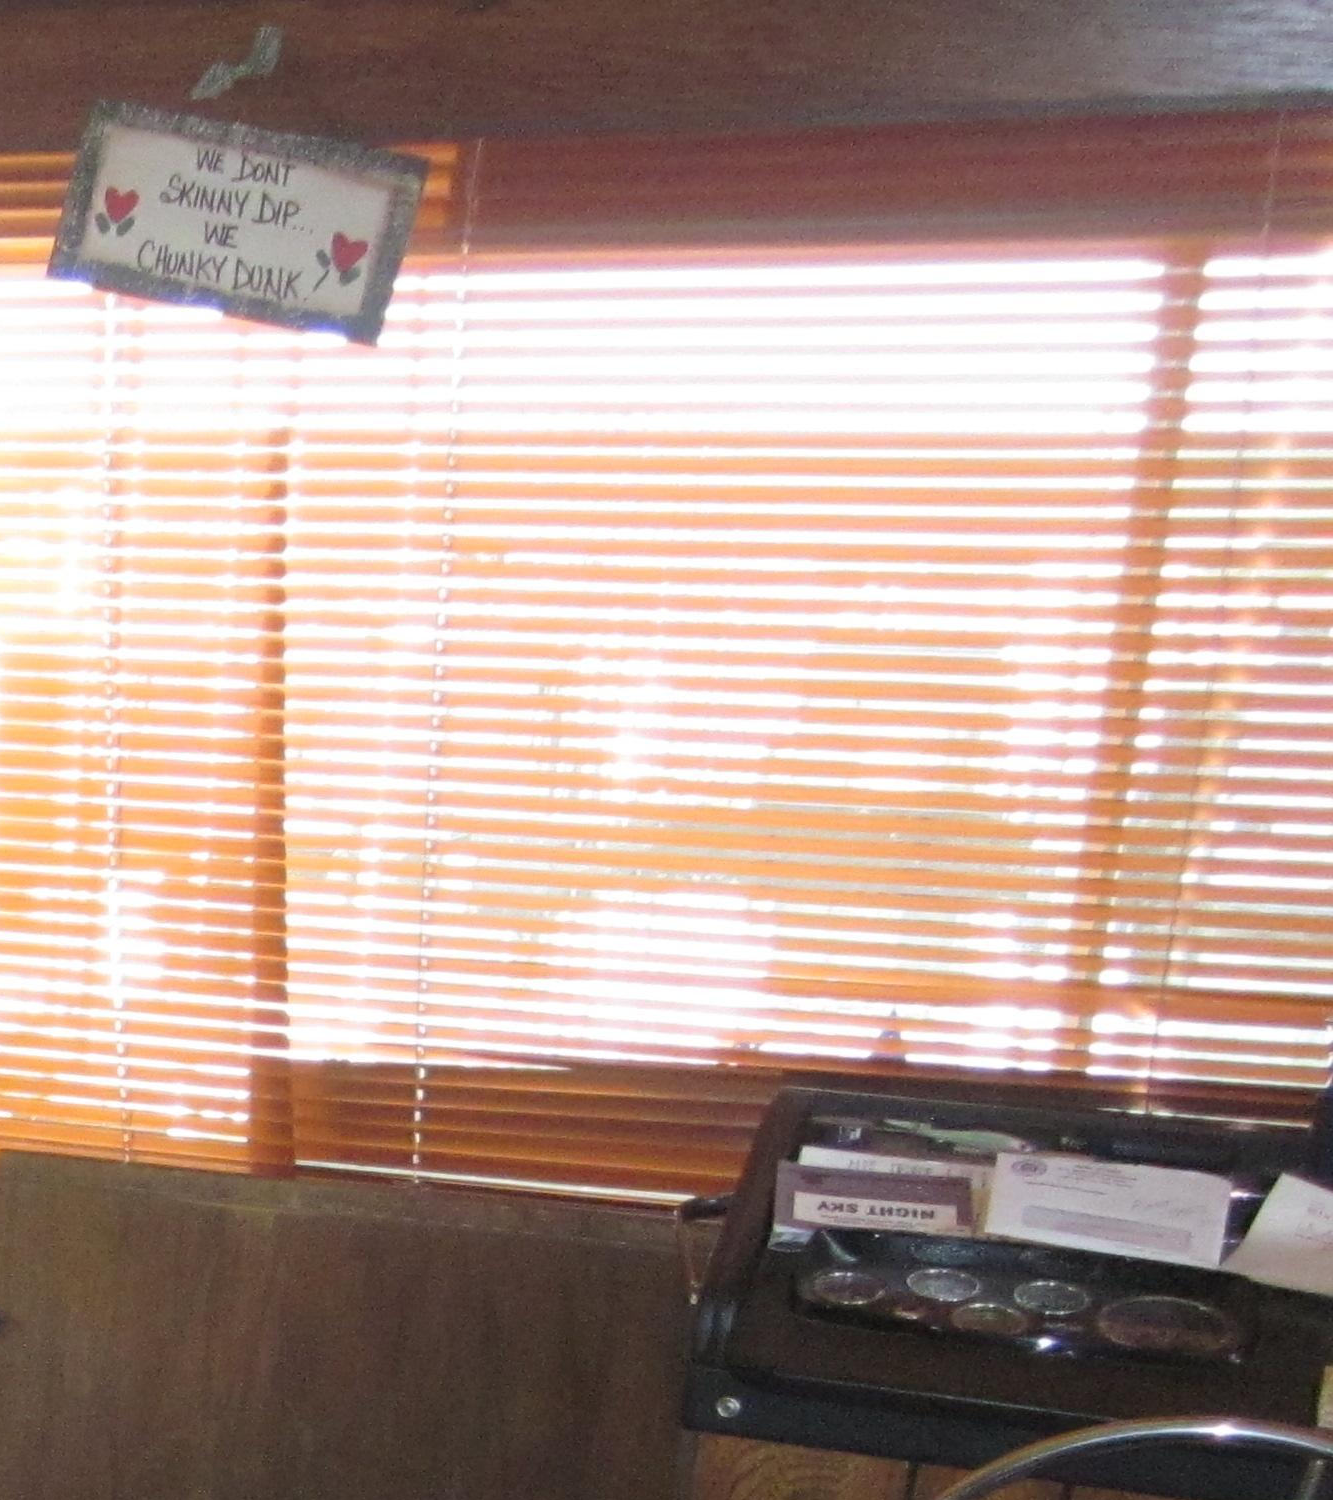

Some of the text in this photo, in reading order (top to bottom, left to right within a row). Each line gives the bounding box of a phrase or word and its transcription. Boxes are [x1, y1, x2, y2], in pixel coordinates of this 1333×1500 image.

[196, 147, 224, 175] WE
[160, 175, 251, 218] SKINNY
[204, 221, 239, 249] WE
[137, 240, 229, 284] CHUNKY
[817, 1200, 936, 1220] NIGHT SKY
